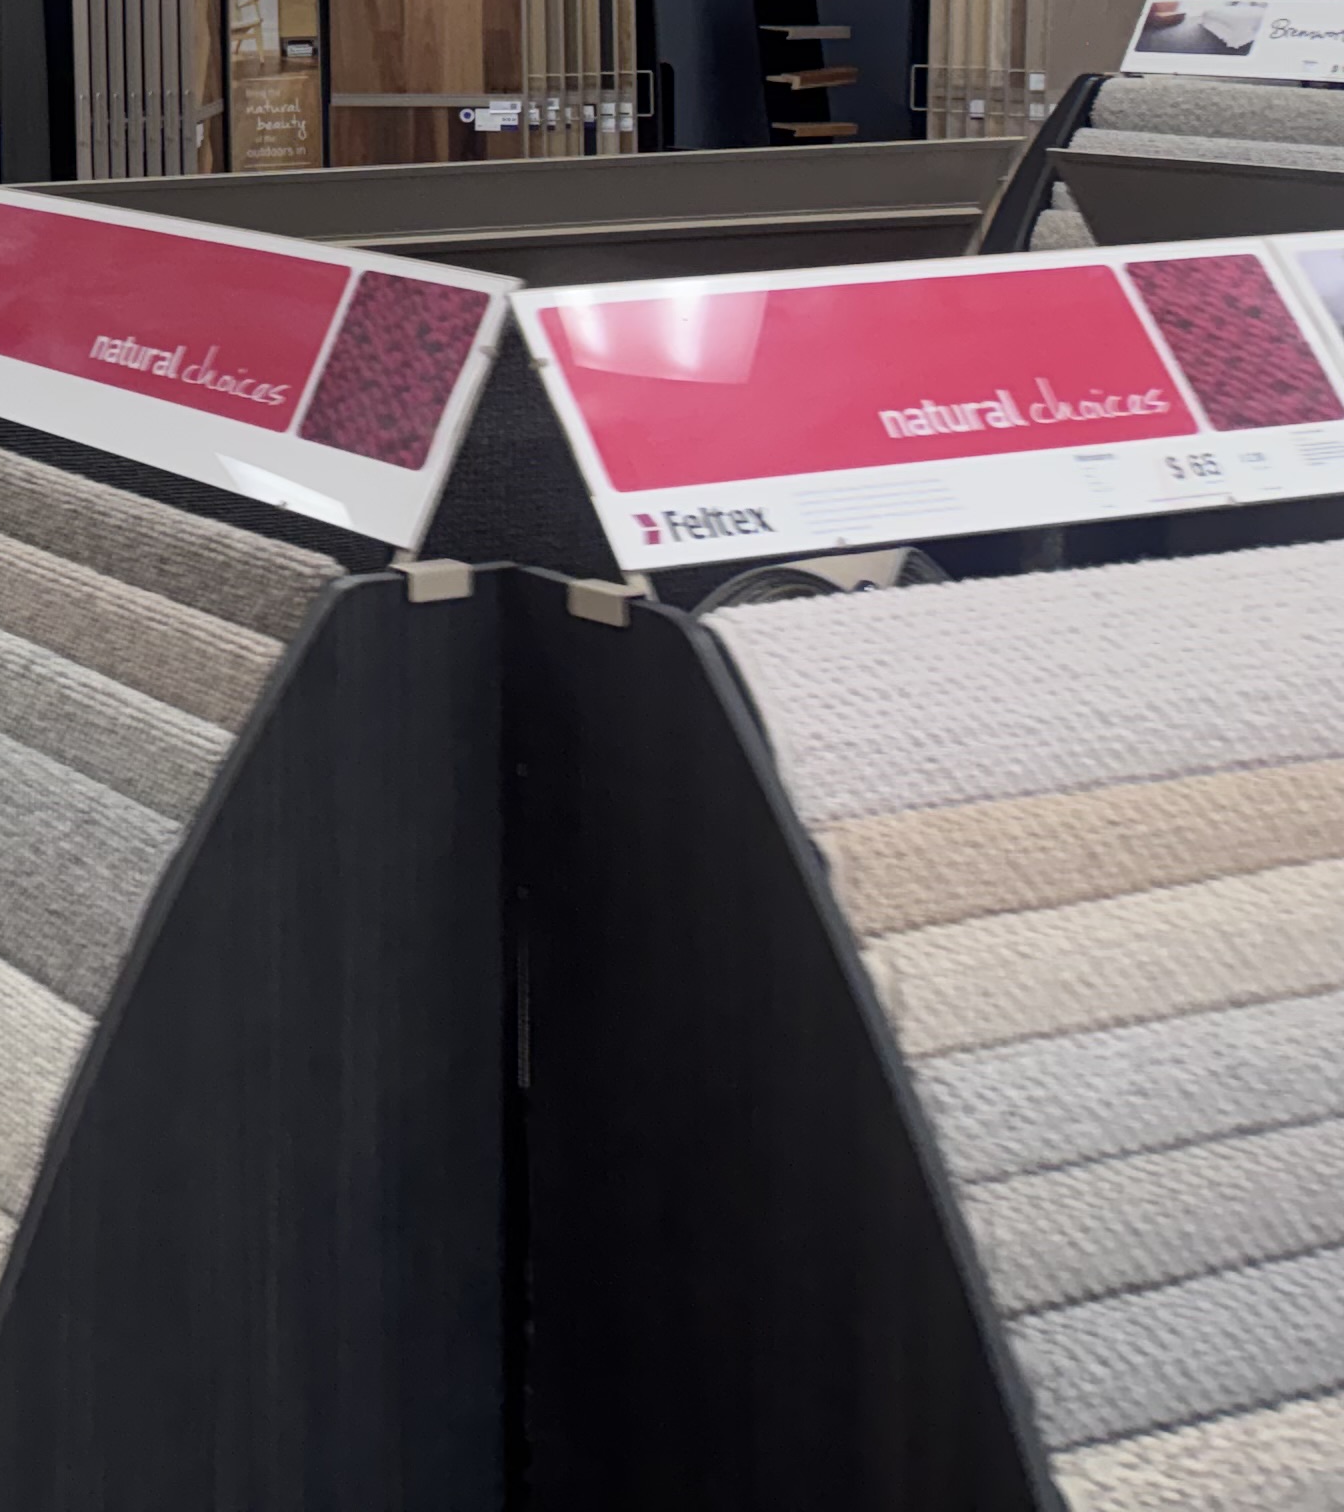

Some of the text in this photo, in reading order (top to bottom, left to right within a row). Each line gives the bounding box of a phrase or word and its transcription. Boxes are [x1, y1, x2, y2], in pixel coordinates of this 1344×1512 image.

[246, 97, 301, 115] natural
[256, 113, 308, 141] beauty
[88, 335, 292, 406] natural choices
[877, 377, 1172, 439] natural choices
[662, 506, 777, 542] Feltex
